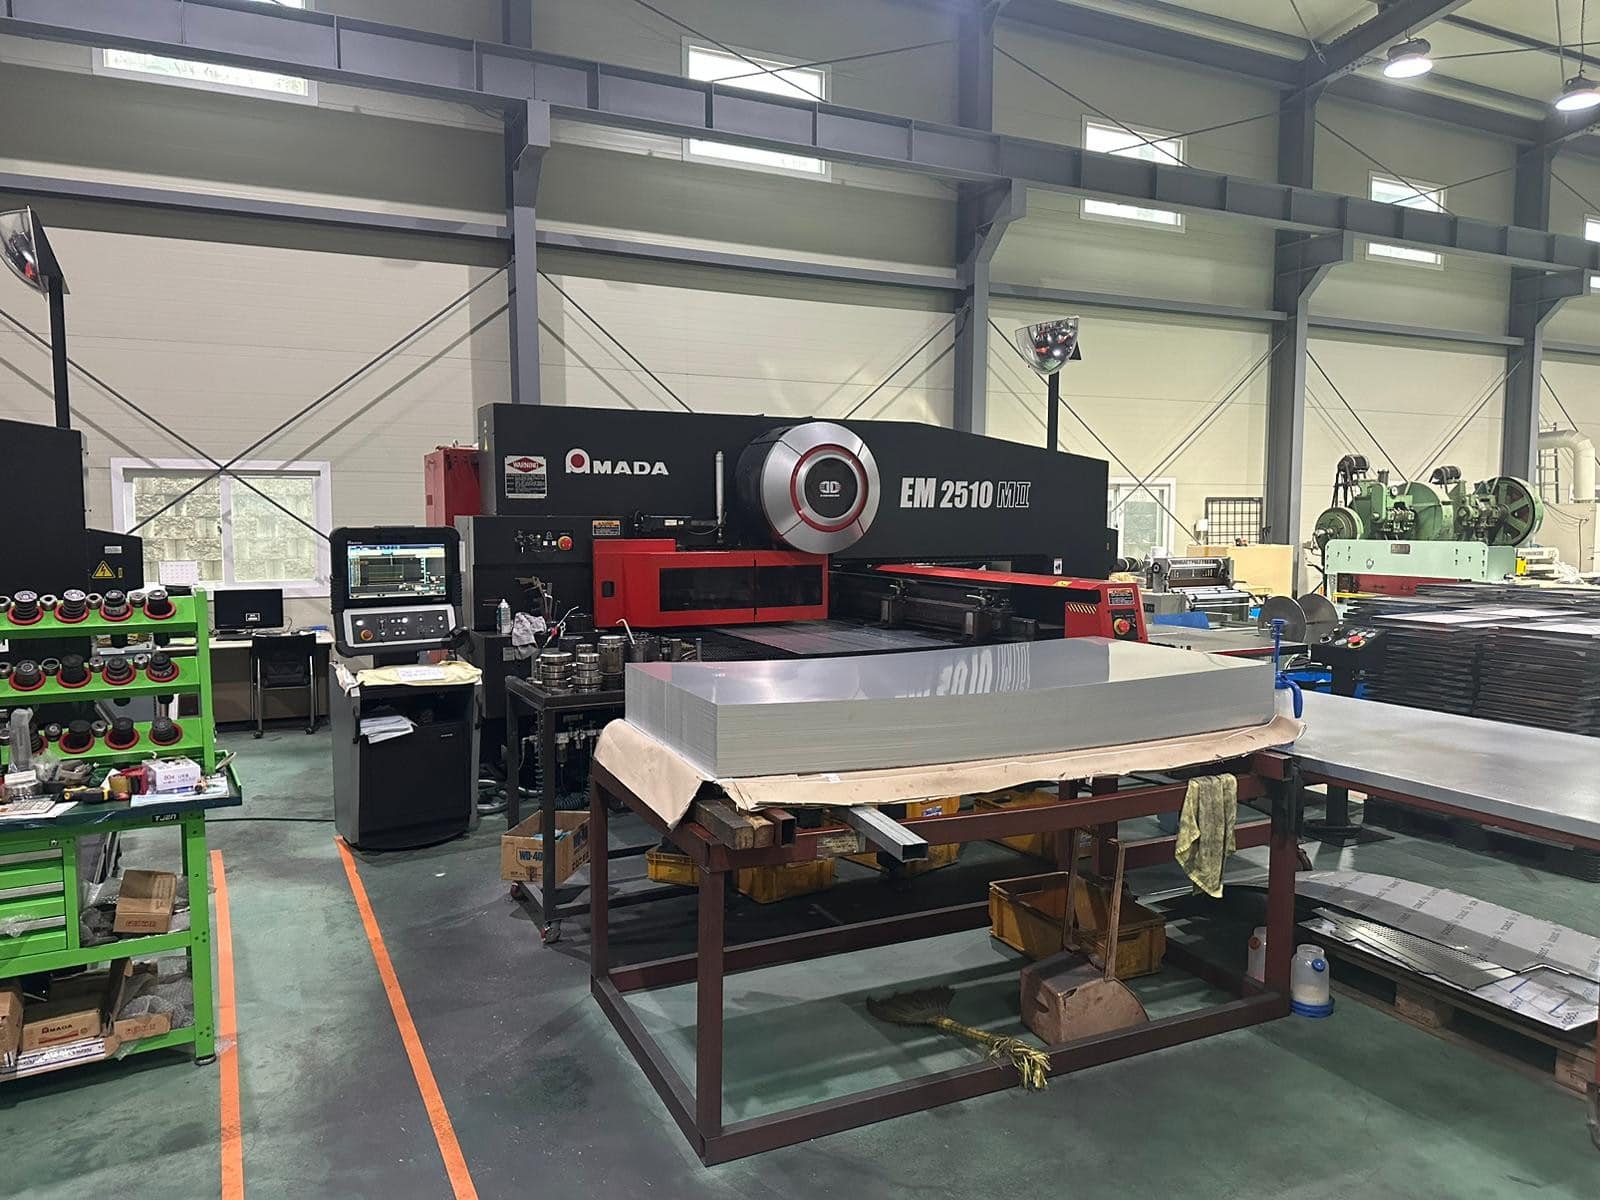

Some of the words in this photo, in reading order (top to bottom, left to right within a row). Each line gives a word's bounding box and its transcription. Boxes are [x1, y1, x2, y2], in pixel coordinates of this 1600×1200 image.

[565, 448, 669, 476] AMADA
[900, 477, 937, 508] EM
[940, 480, 994, 508] 2510
